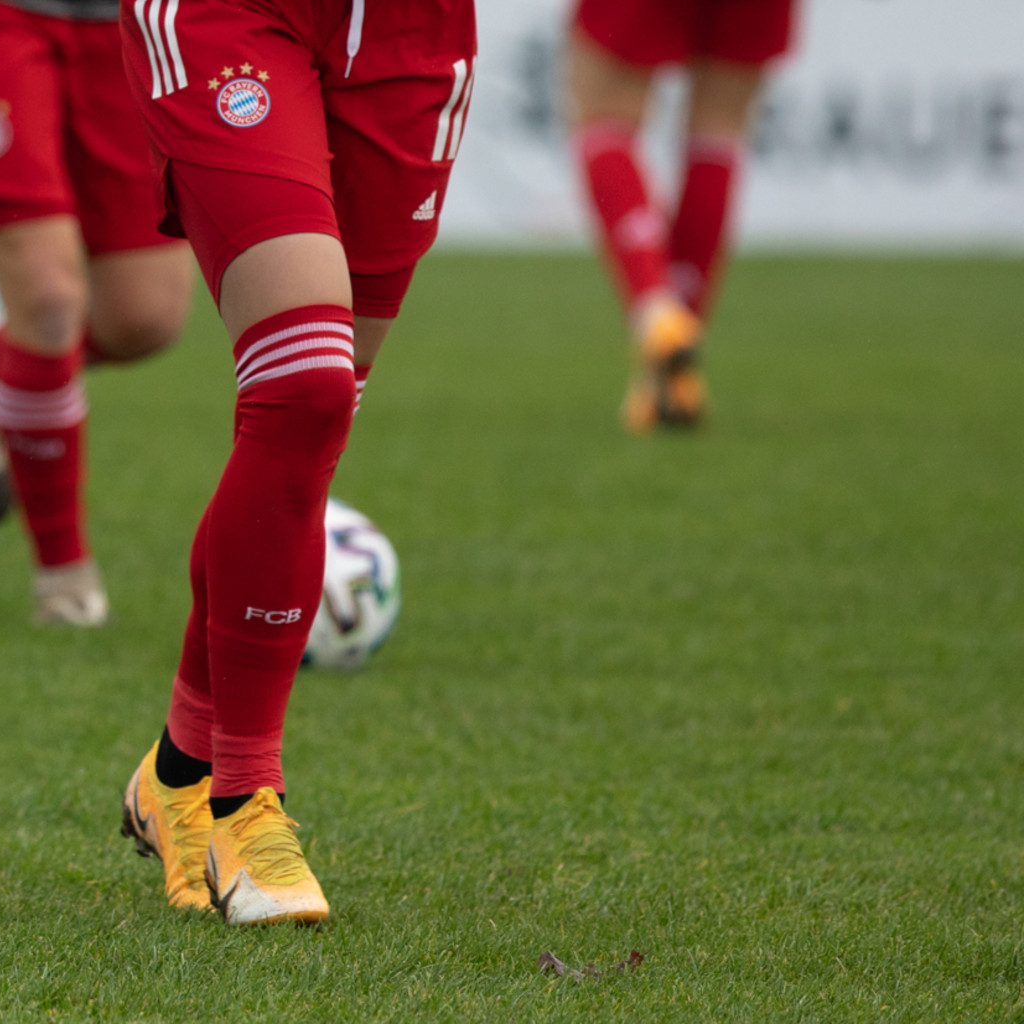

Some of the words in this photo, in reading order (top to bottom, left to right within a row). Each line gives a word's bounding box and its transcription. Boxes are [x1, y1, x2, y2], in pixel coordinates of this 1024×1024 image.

[220, 91, 230, 104] FC
[229, 82, 264, 98] BAYERN
[245, 606, 303, 625] FCB
